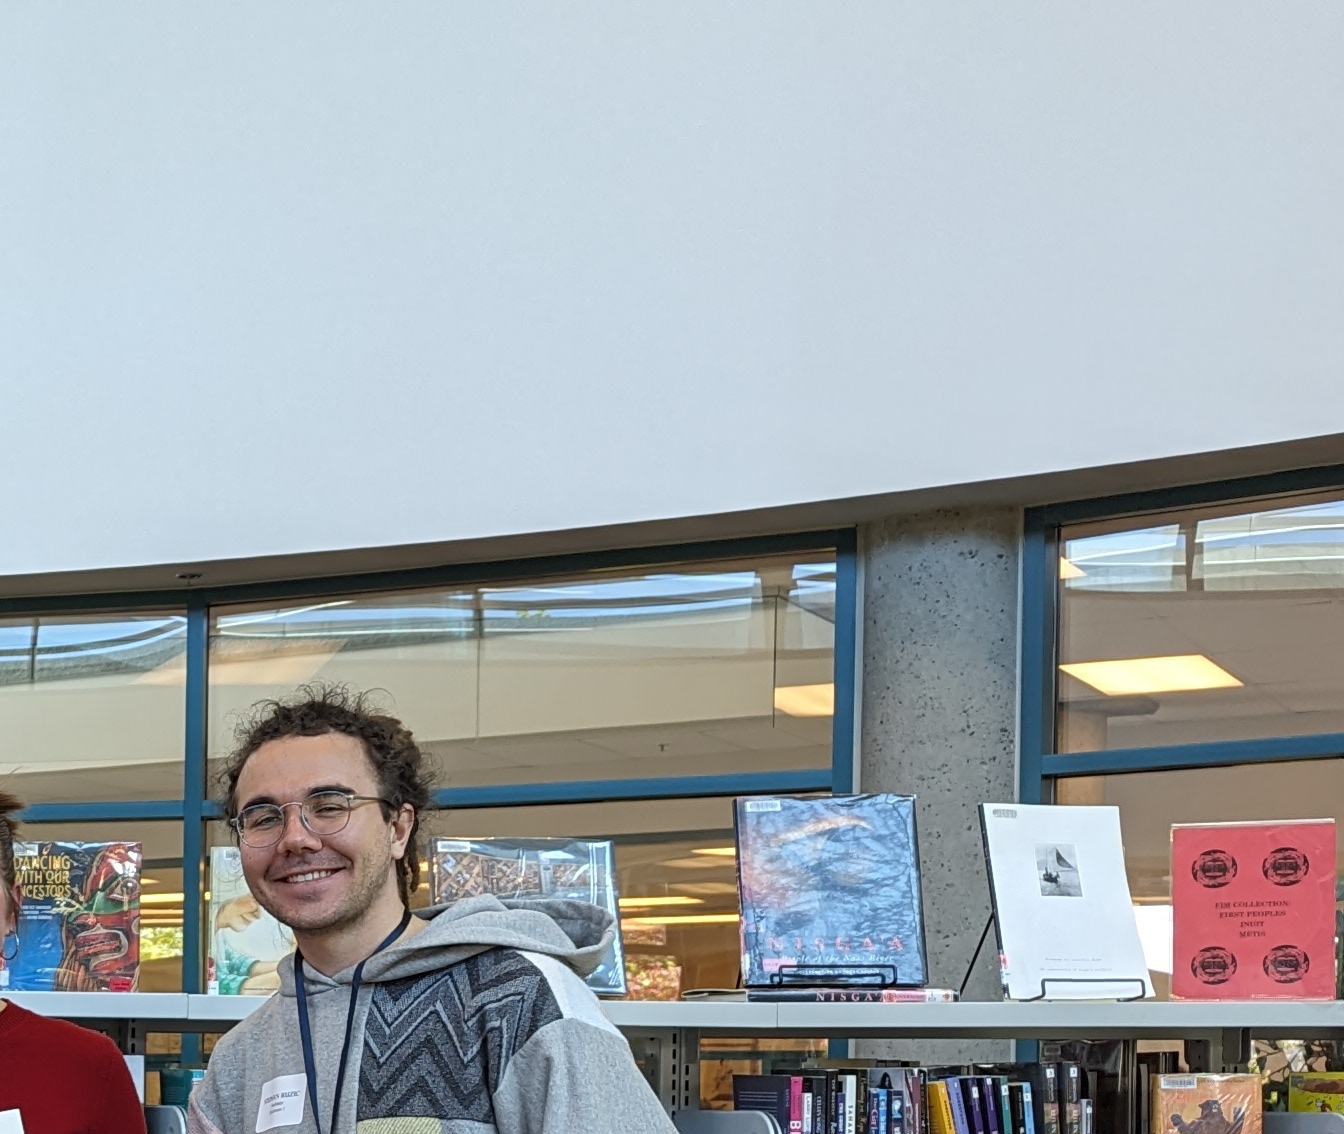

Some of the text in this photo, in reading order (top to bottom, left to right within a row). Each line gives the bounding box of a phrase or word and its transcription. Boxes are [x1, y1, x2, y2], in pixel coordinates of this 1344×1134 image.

[14, 855, 71, 870] DANCING
[15, 870, 70, 885] WITH OUR
[20, 884, 71, 901] NCESTORS
[1219, 910, 1287, 919] FIRST PEOPLES
